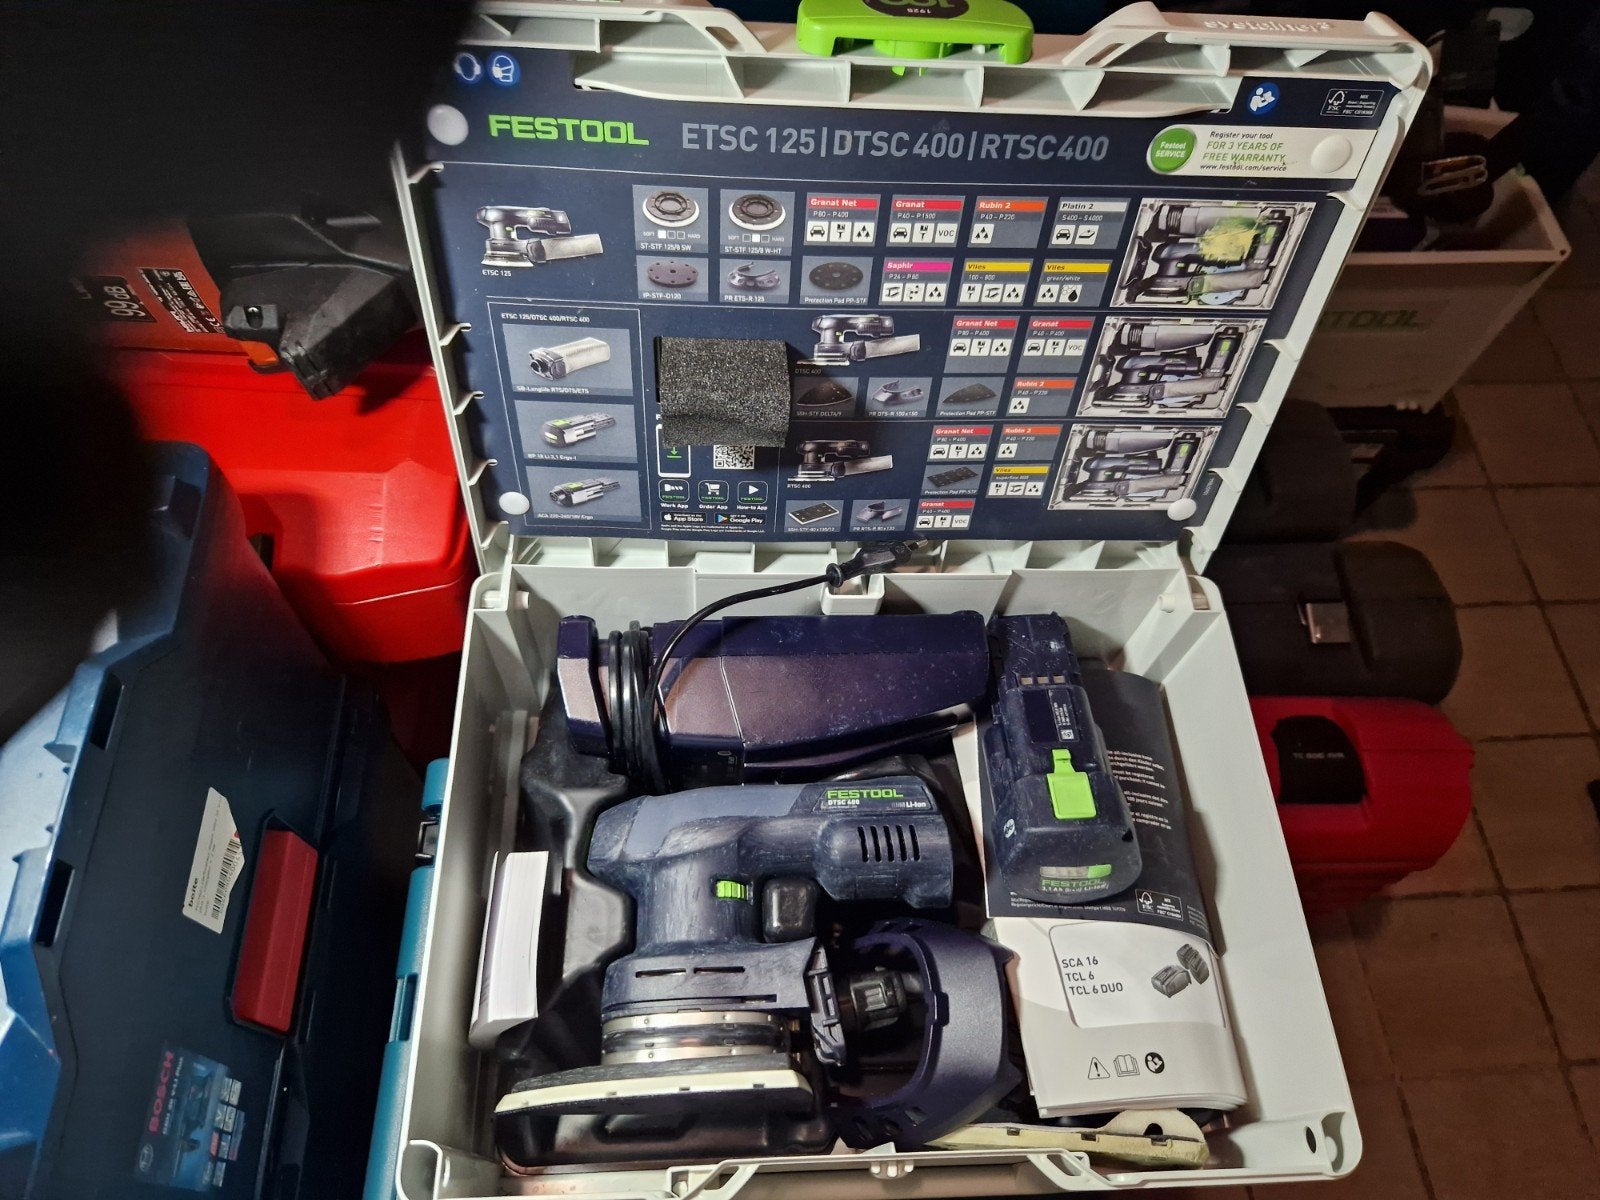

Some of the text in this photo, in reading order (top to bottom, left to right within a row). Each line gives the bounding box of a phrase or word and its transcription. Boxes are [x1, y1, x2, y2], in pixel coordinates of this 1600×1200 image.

[489, 114, 650, 146] FESTOOL
[1210, 131, 1240, 139] Register
[1241, 132, 1257, 140] your
[682, 122, 1110, 163] ETSC 125 DTSC 400 RTSC 400
[1159, 141, 1186, 150] Festool
[1206, 141, 1284, 151] FOR 3 YEARS OF
[1155, 150, 1186, 158] SERVICE
[1203, 152, 1286, 162] FREE WARRANTY
[810, 198, 857, 207] Granat Net
[895, 200, 925, 208] Granat
[640, 243, 663, 251] ST-STF
[681, 244, 692, 252] SW
[765, 247, 783, 255] W-HT
[887, 262, 914, 271] Saphir
[827, 788, 904, 800] FESTOOL
[1041, 878, 1106, 888] FESTOOL
[1061, 955, 1098, 969] SCA 16
[1065, 970, 1095, 982] TCL 6
[1069, 982, 1123, 996] TCL 6 DUO
[149, 1050, 174, 1133] BOSCH
